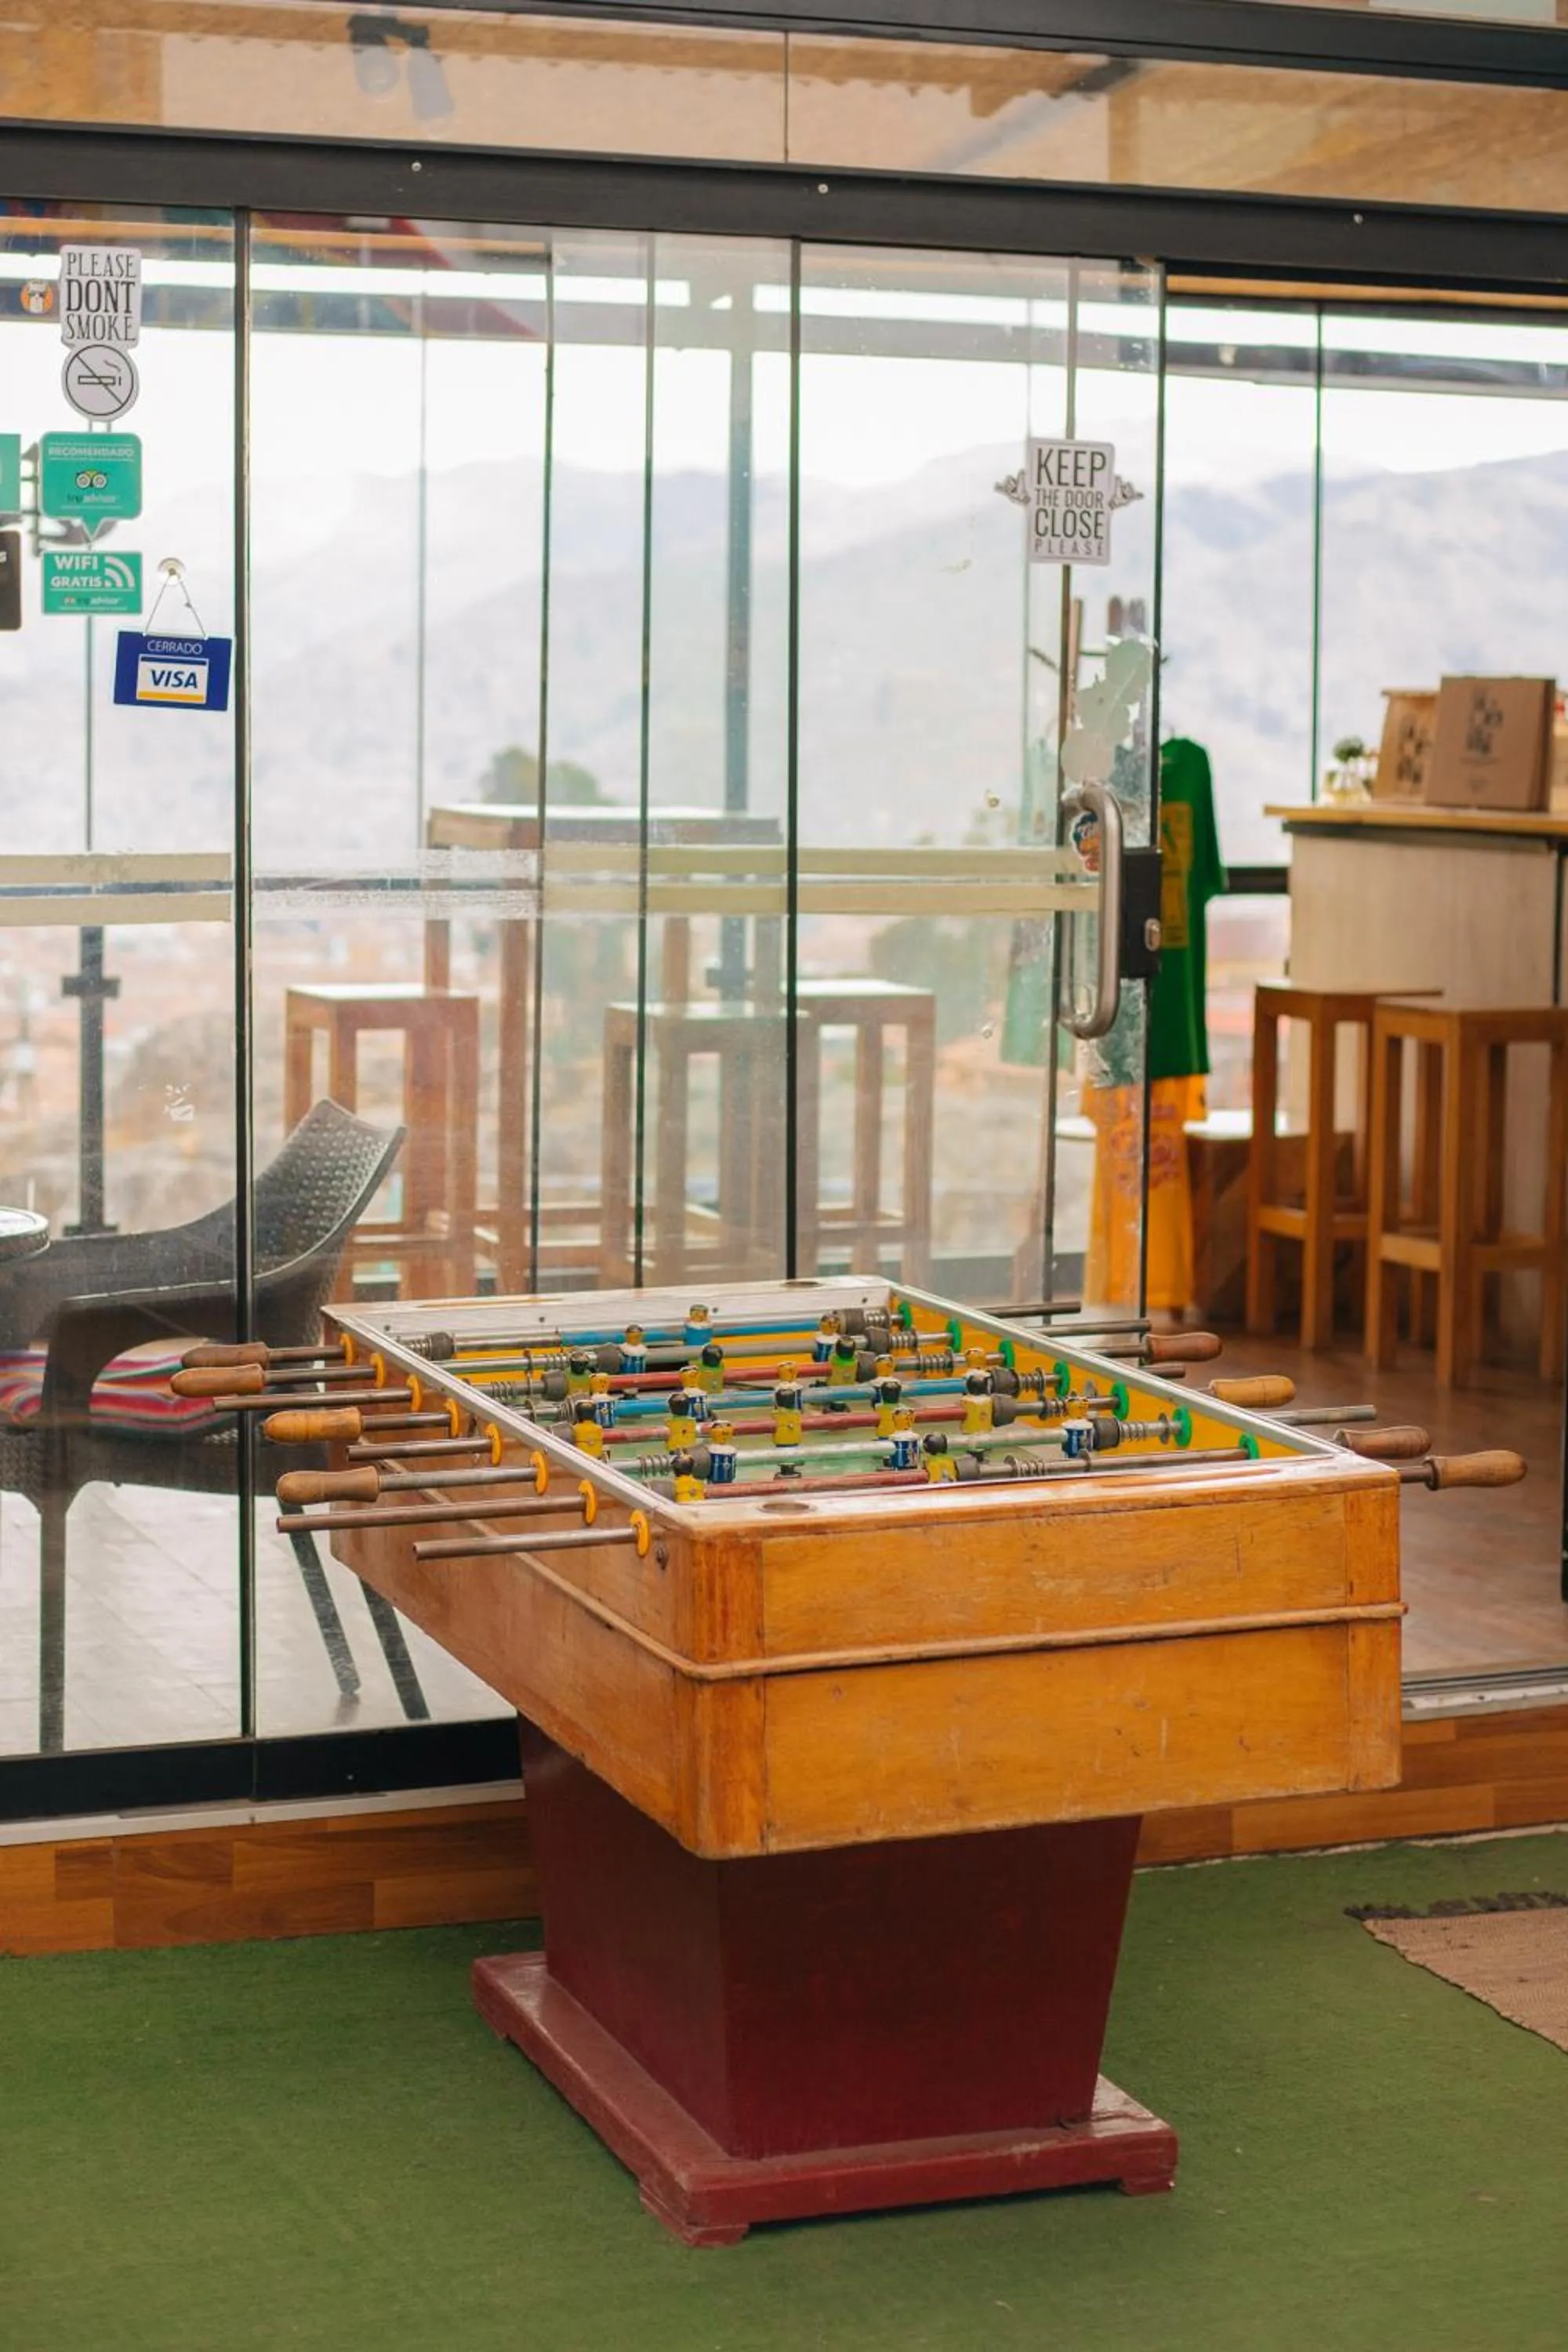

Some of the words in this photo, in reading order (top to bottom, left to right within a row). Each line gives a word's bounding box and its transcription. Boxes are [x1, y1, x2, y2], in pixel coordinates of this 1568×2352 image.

[67, 252, 136, 278] PLEASE
[66, 279, 136, 314] DONT
[67, 314, 136, 341] SMOKE
[49, 446, 134, 457] RECOMENDADO
[1037, 448, 1106, 488] KEEP
[1036, 488, 1060, 506] THE
[1065, 490, 1104, 509] DOOR
[1035, 507, 1104, 539] CLOSE
[1035, 538, 1103, 557] PLEASE
[54, 555, 98, 570] WIFI
[51, 575, 102, 587] GRATIS
[147, 640, 203, 654] CERRADO
[151, 669, 198, 688] VISA
